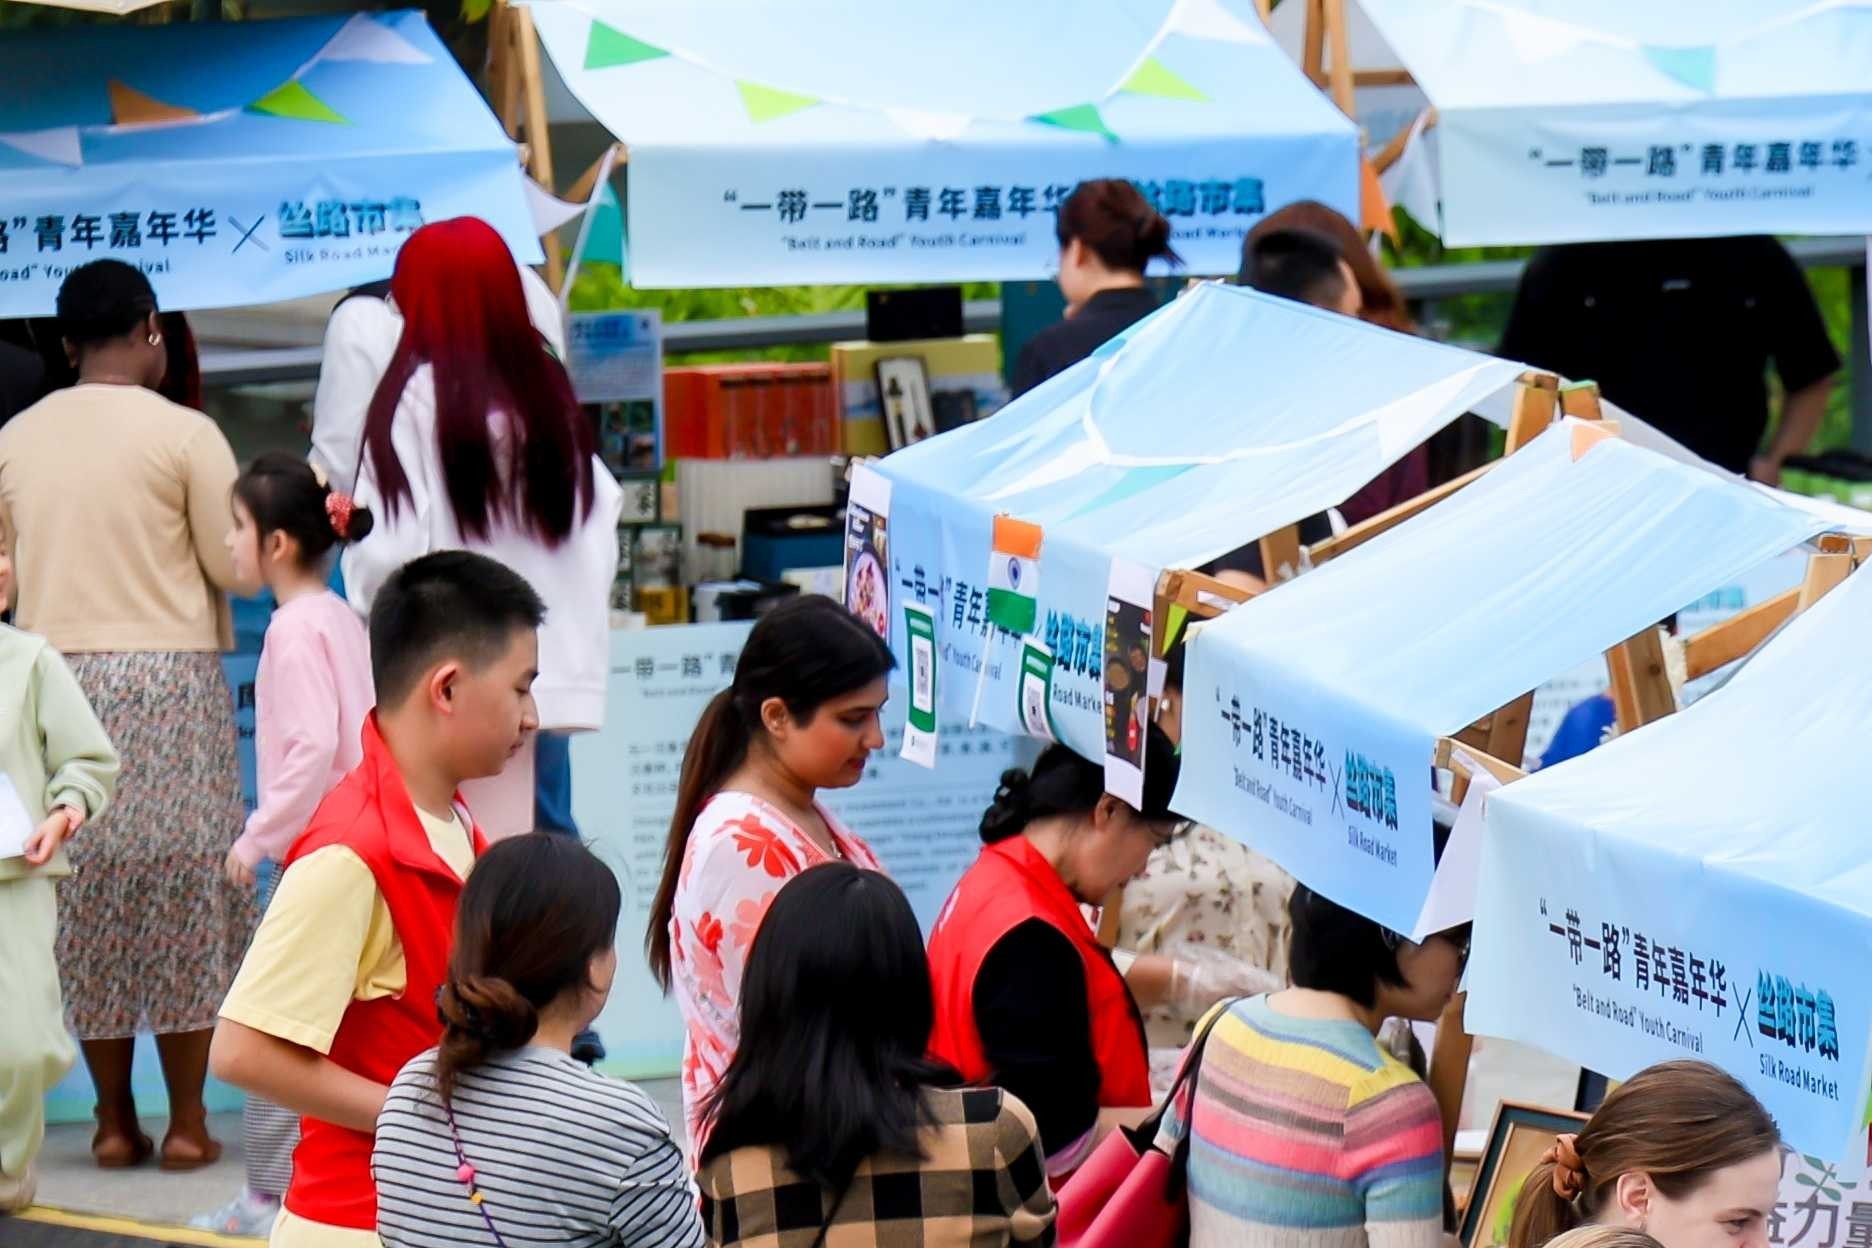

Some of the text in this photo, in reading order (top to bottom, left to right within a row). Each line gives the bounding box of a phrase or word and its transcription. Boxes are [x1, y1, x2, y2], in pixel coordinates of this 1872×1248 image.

[1075, 687, 1101, 714] Marke
[1375, 837, 1397, 867] Market
[1539, 898, 1727, 1018] “一带一路”青年嘉年华
[1595, 997, 1611, 1020] and
[1640, 1011, 1665, 1039] Youth
[1666, 1020, 1703, 1054] Carnival
[1757, 967, 1839, 1062] 丝路市集
[1760, 1053, 1839, 1101] Silk Road Market
